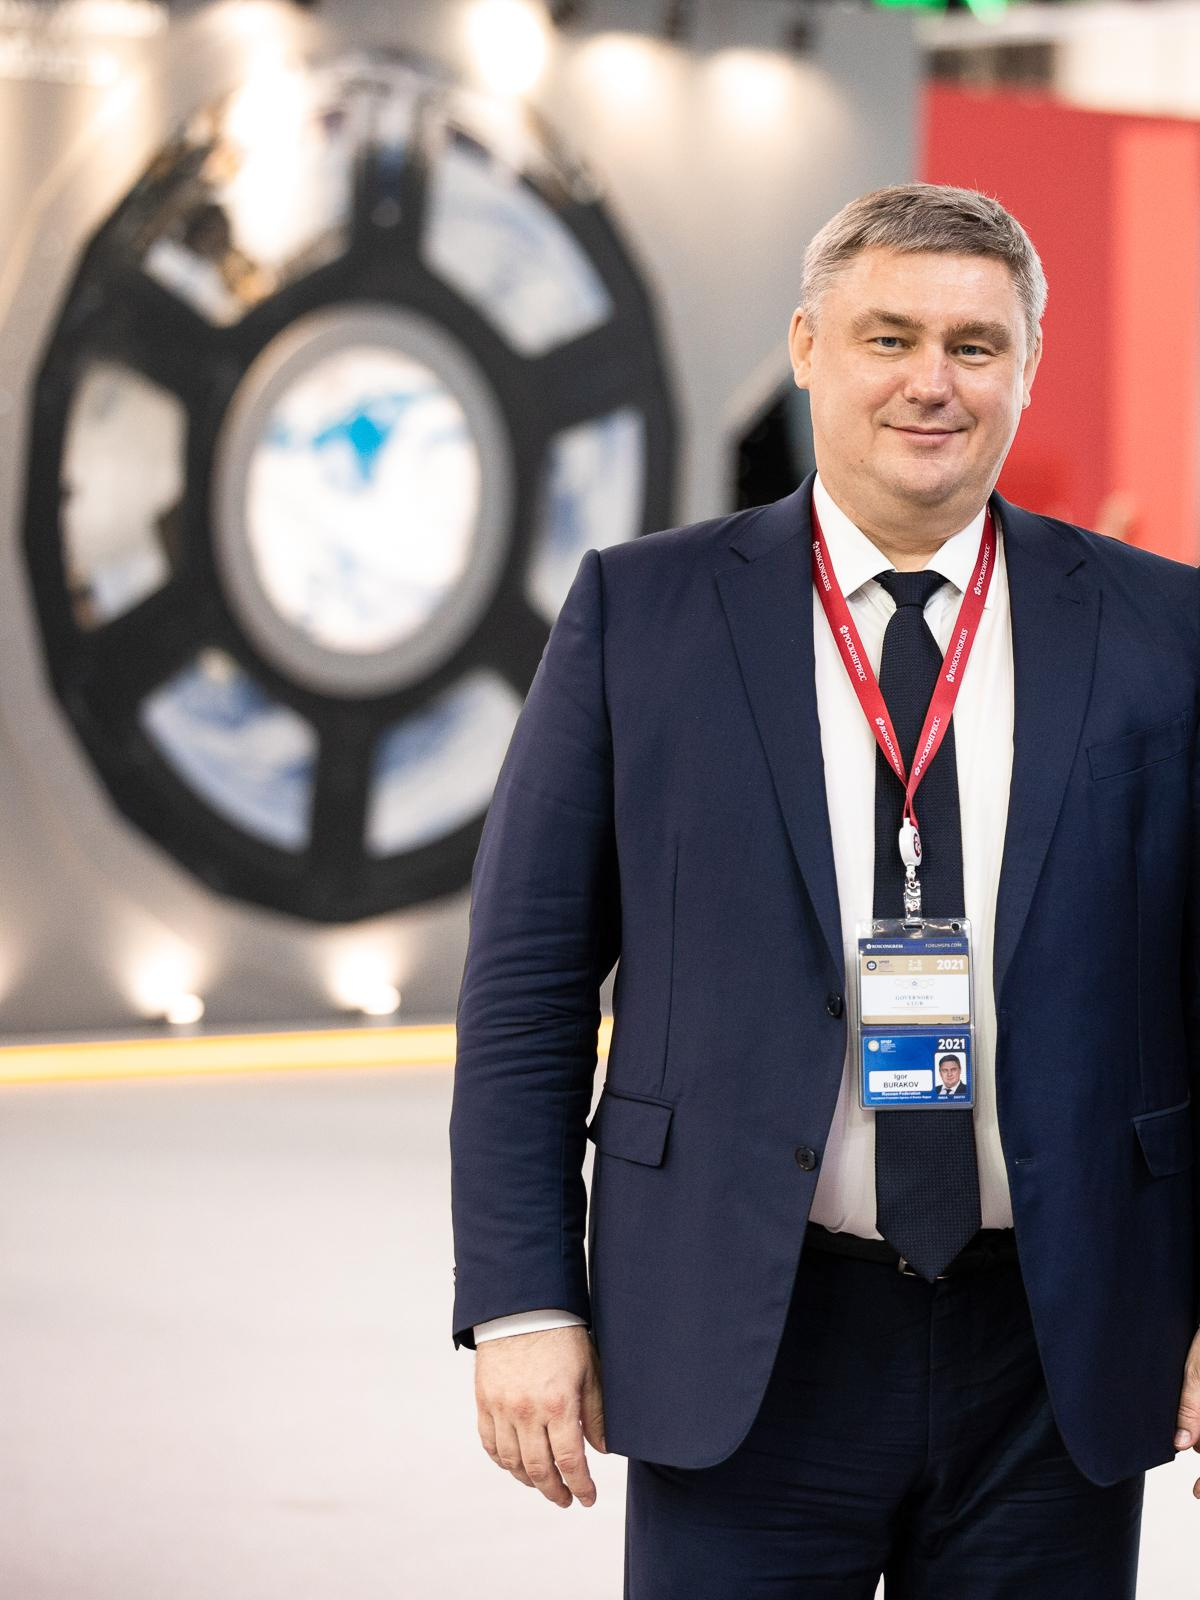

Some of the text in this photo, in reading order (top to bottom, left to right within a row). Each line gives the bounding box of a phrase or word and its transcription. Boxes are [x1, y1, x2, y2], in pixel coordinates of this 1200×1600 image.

[815, 548, 831, 591] ROSCONGRESS
[977, 544, 990, 589] РОСКОНГРЕСС
[843, 632, 867, 682] РОСКОНГРЕСС
[949, 628, 968, 675] ROSCONGRESS
[918, 717, 940, 767] РОСКОНГРЕСС
[936, 959, 964, 970] 2021
[938, 1038, 965, 1050] 2021
